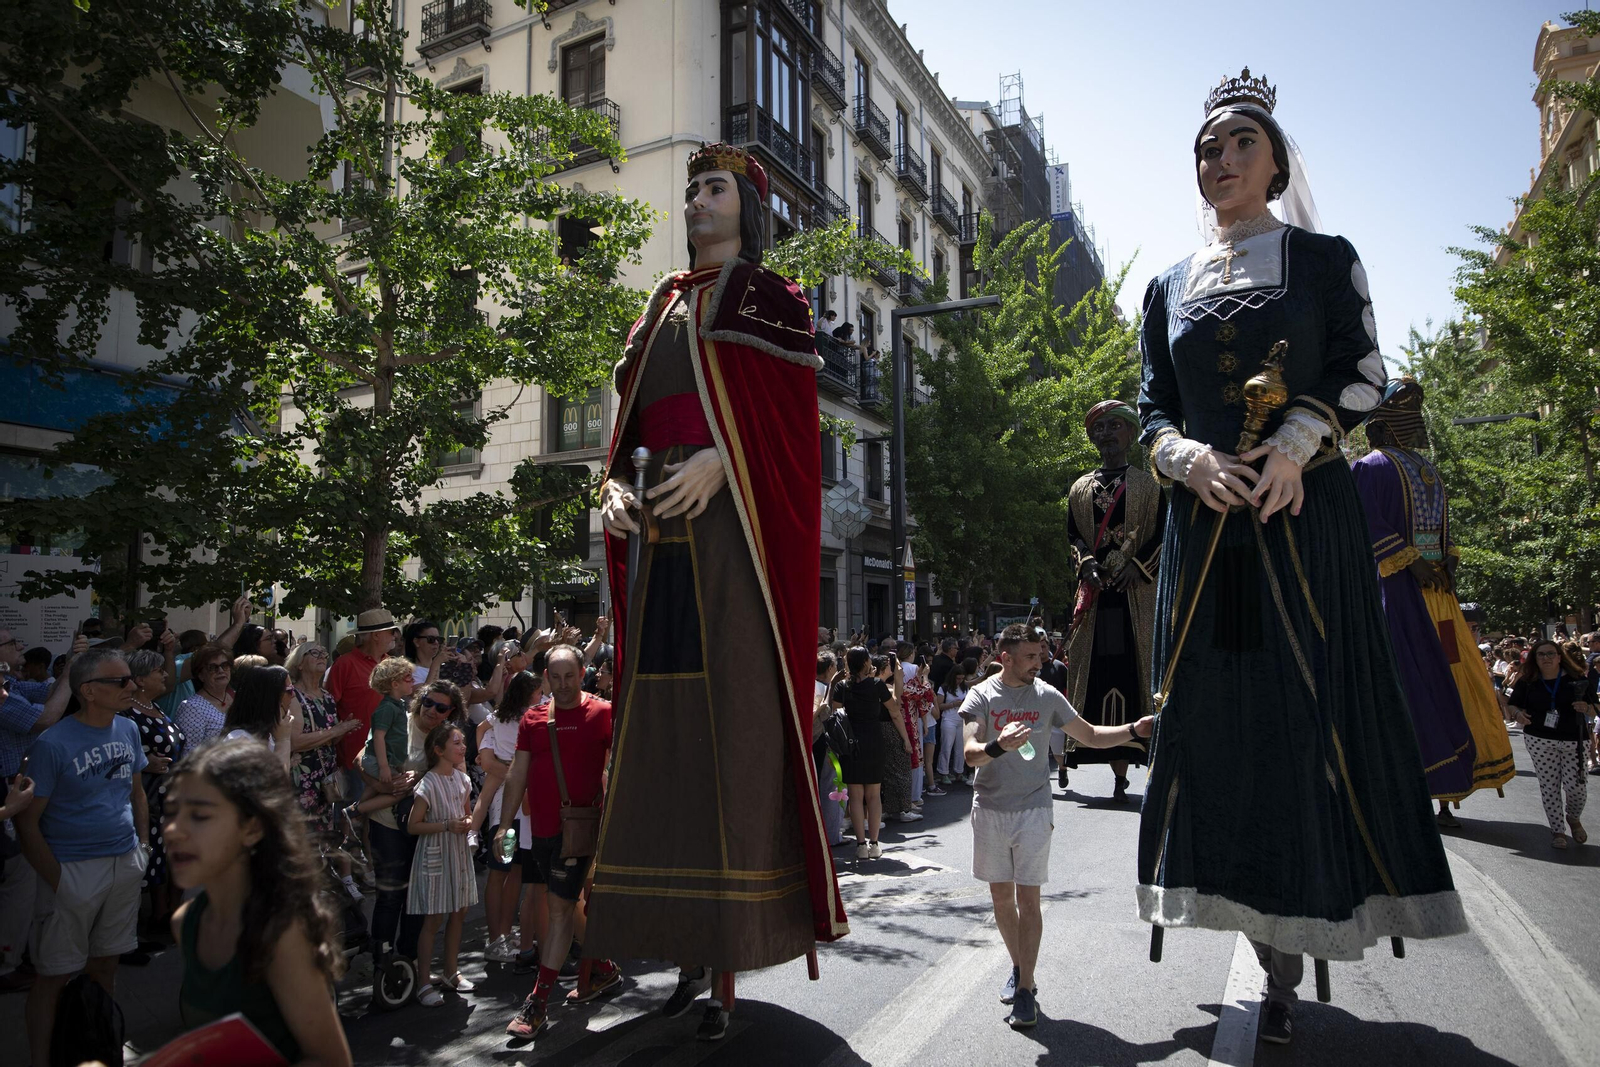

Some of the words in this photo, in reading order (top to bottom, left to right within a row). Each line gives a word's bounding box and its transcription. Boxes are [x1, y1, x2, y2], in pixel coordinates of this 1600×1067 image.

[564, 422, 578, 432] 600
[588, 419, 602, 428] 600
[864, 556, 892, 570] McDonald's
[990, 708, 1040, 732] Champ
[72, 746, 102, 776] LAS
[102, 742, 135, 762] VEGAS
